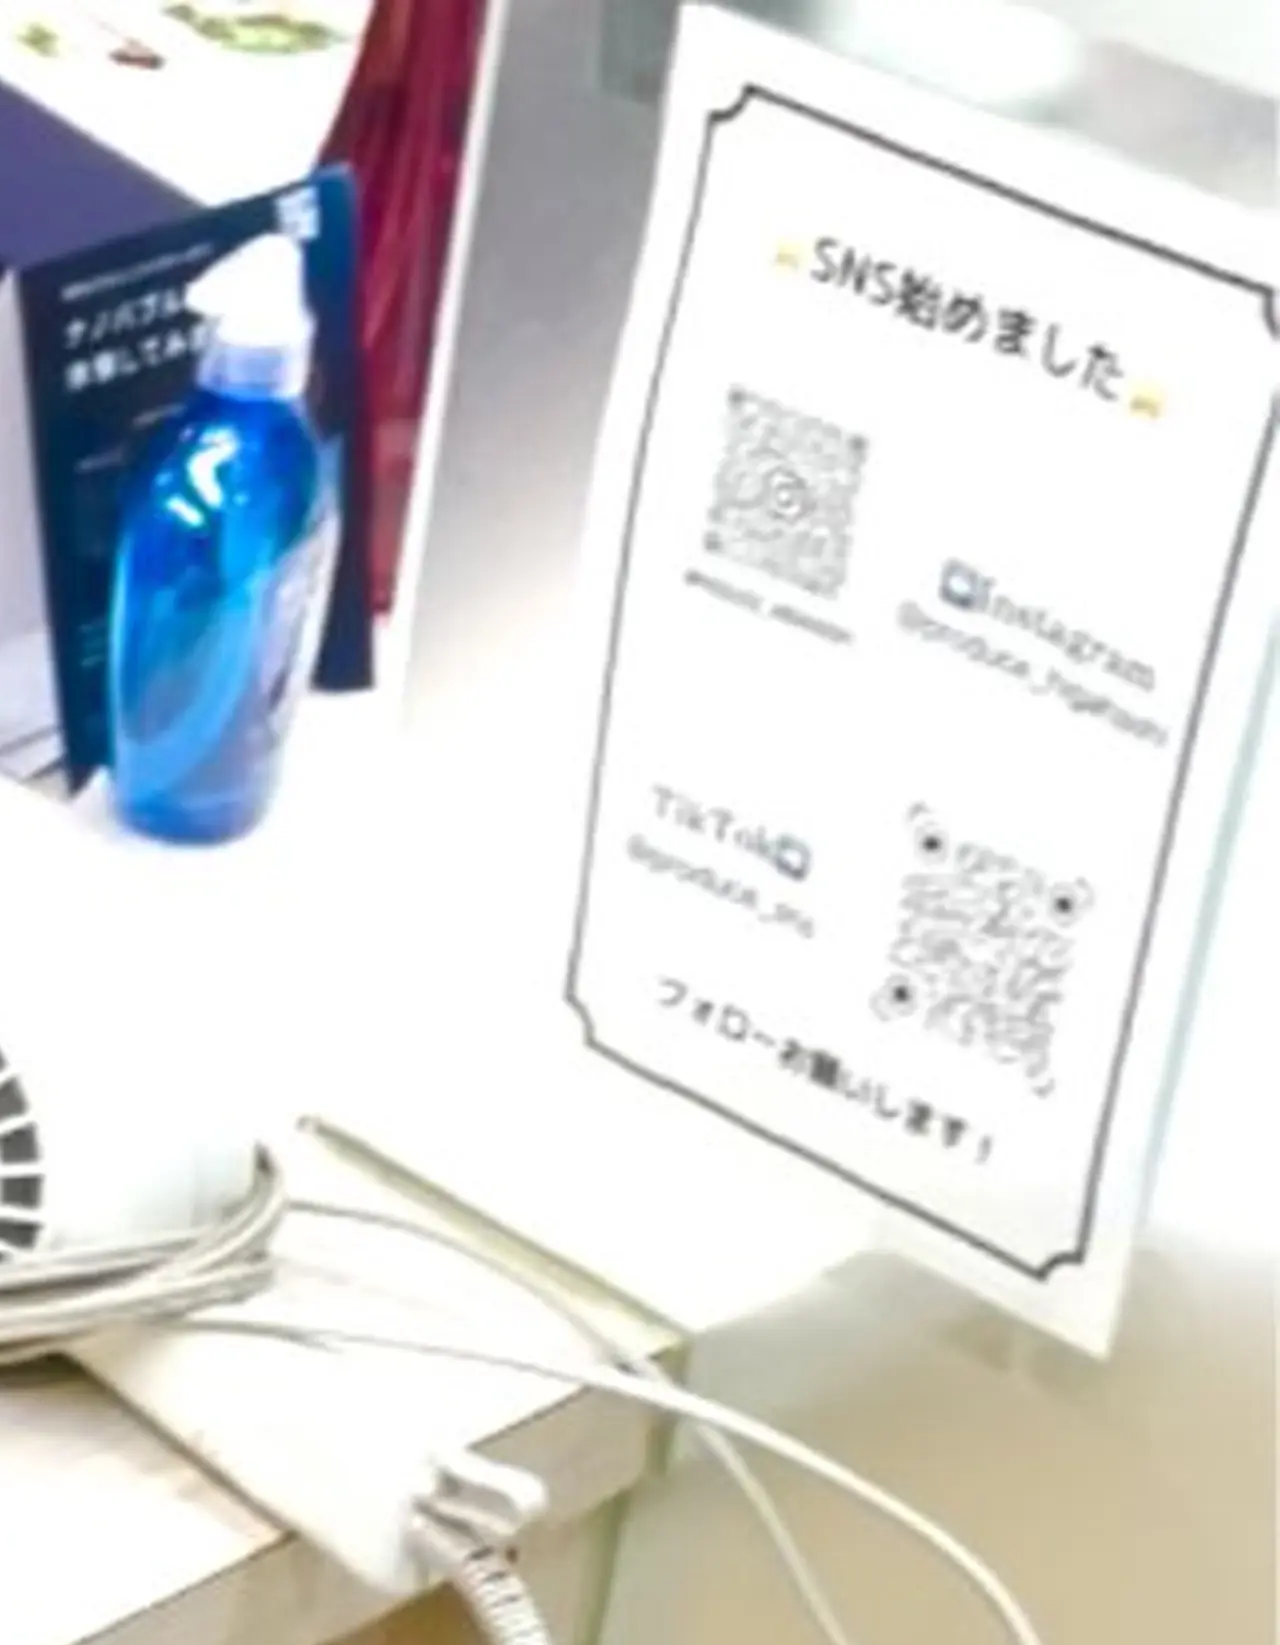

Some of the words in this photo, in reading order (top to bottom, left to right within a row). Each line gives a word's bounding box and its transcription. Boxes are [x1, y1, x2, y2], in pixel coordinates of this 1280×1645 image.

[810, 236, 1124, 402] SNS始めました
